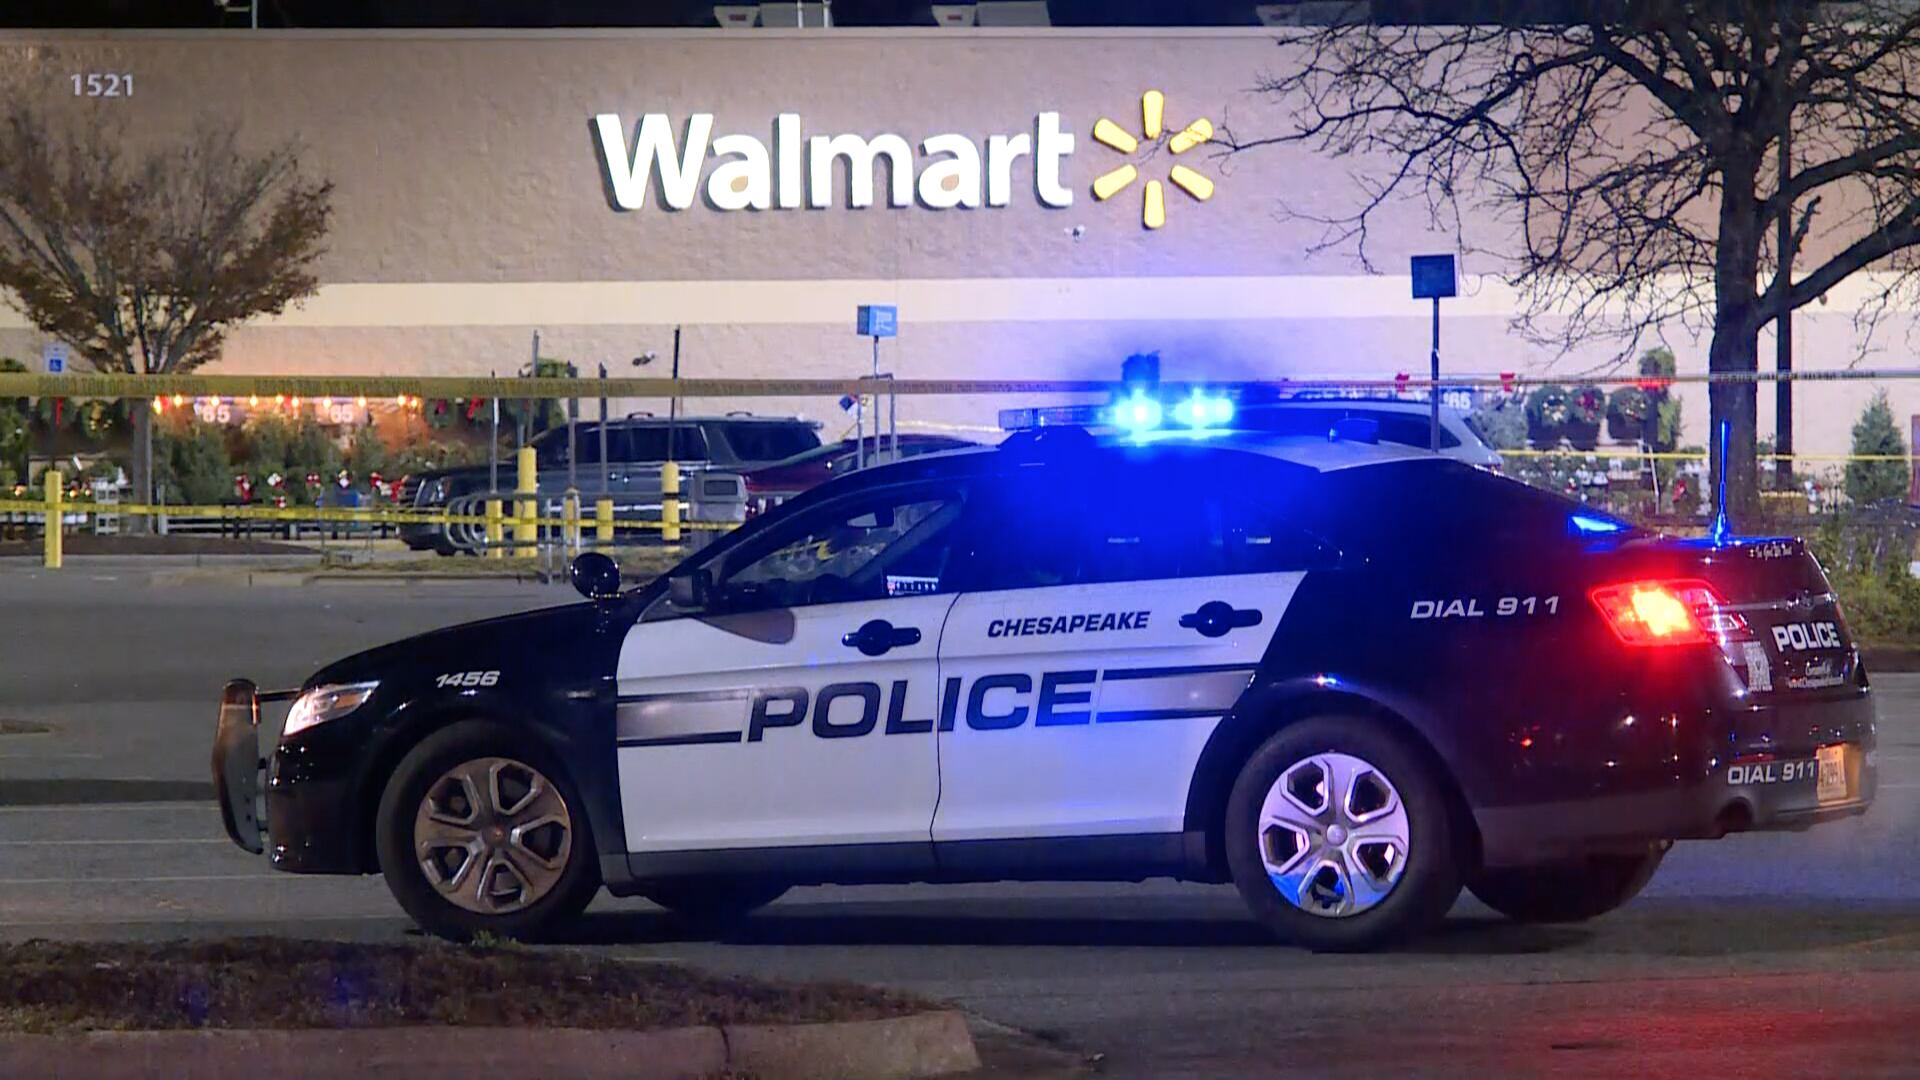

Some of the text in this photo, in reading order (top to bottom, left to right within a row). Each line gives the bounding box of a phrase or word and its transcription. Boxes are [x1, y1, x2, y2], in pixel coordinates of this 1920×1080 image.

[70, 73, 133, 96] 1521
[594, 111, 1076, 211] Walmart
[1410, 596, 1560, 619] DIAL 911
[987, 610, 1151, 638] CHESAPEAKE
[1771, 622, 1841, 653] POLICE
[435, 670, 501, 688] 1456
[746, 669, 1098, 743] POLICE
[1727, 761, 1815, 785] DIAL 911
